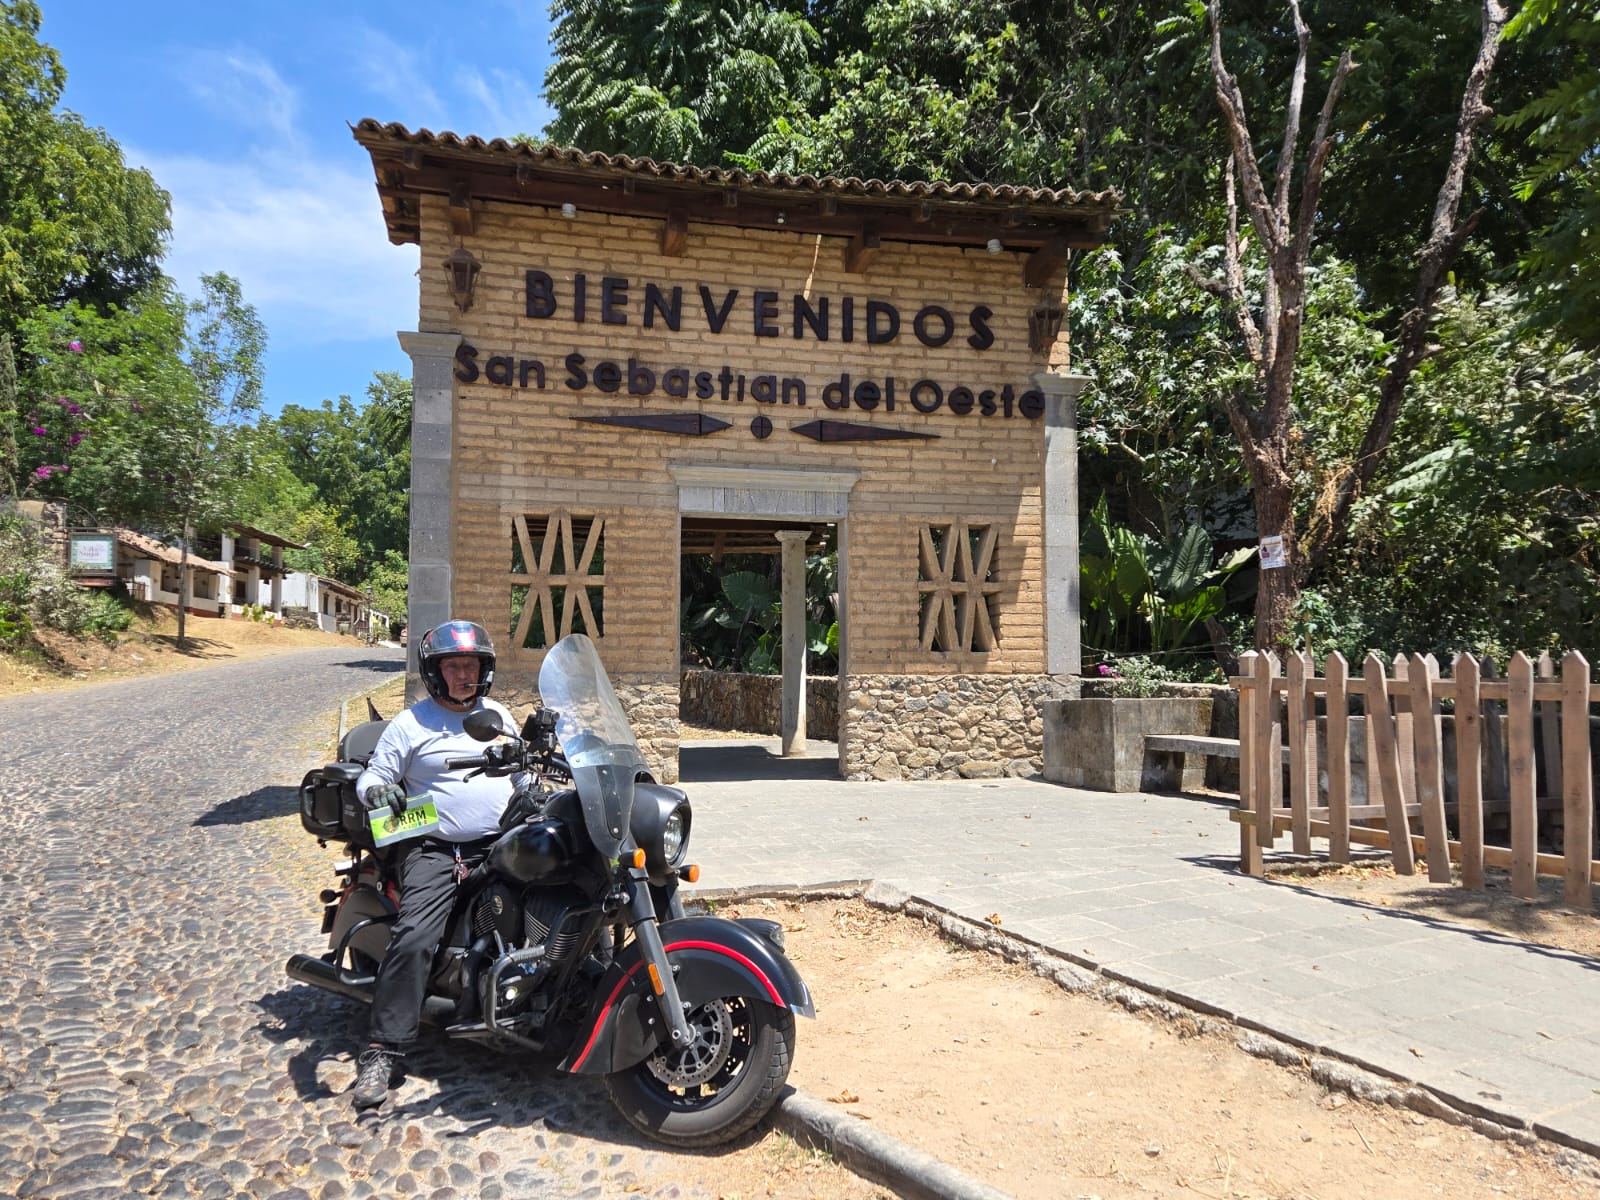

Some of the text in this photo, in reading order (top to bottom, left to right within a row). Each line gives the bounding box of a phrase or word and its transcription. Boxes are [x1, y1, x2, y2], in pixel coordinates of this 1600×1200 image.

[526, 270, 995, 350] BIENVENIDOS
[455, 345, 1045, 419] San Sebastian del Oeste
[400, 810, 426, 825] RRM
